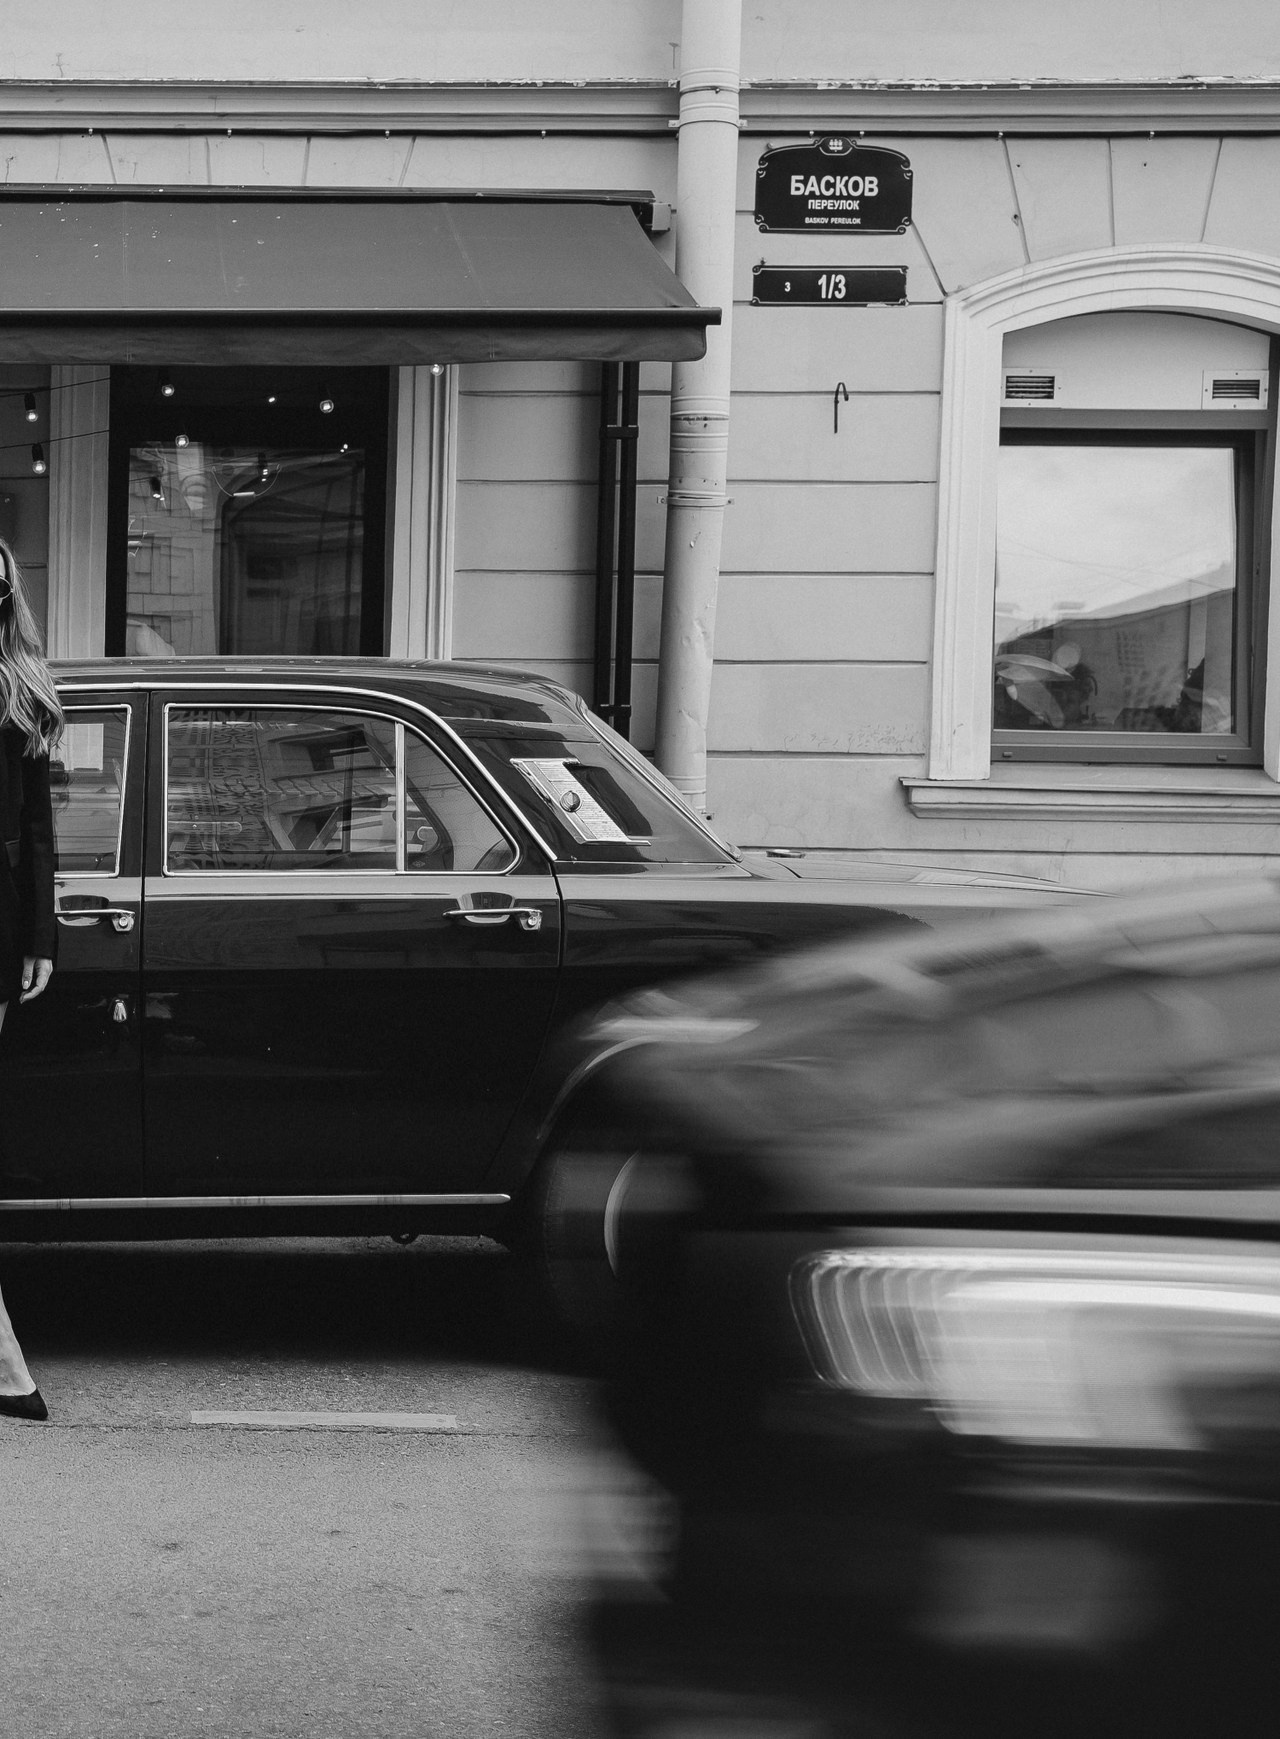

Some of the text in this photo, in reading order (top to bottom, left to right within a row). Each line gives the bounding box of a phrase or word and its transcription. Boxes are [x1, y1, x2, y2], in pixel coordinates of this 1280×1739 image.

[790, 175, 879, 197] БАСКОВ
[808, 200, 860, 210] ПЕРЕУЛОК
[804, 216, 861, 225] BASKOV PEREULOK
[784, 274, 846, 299] 3 1/3
